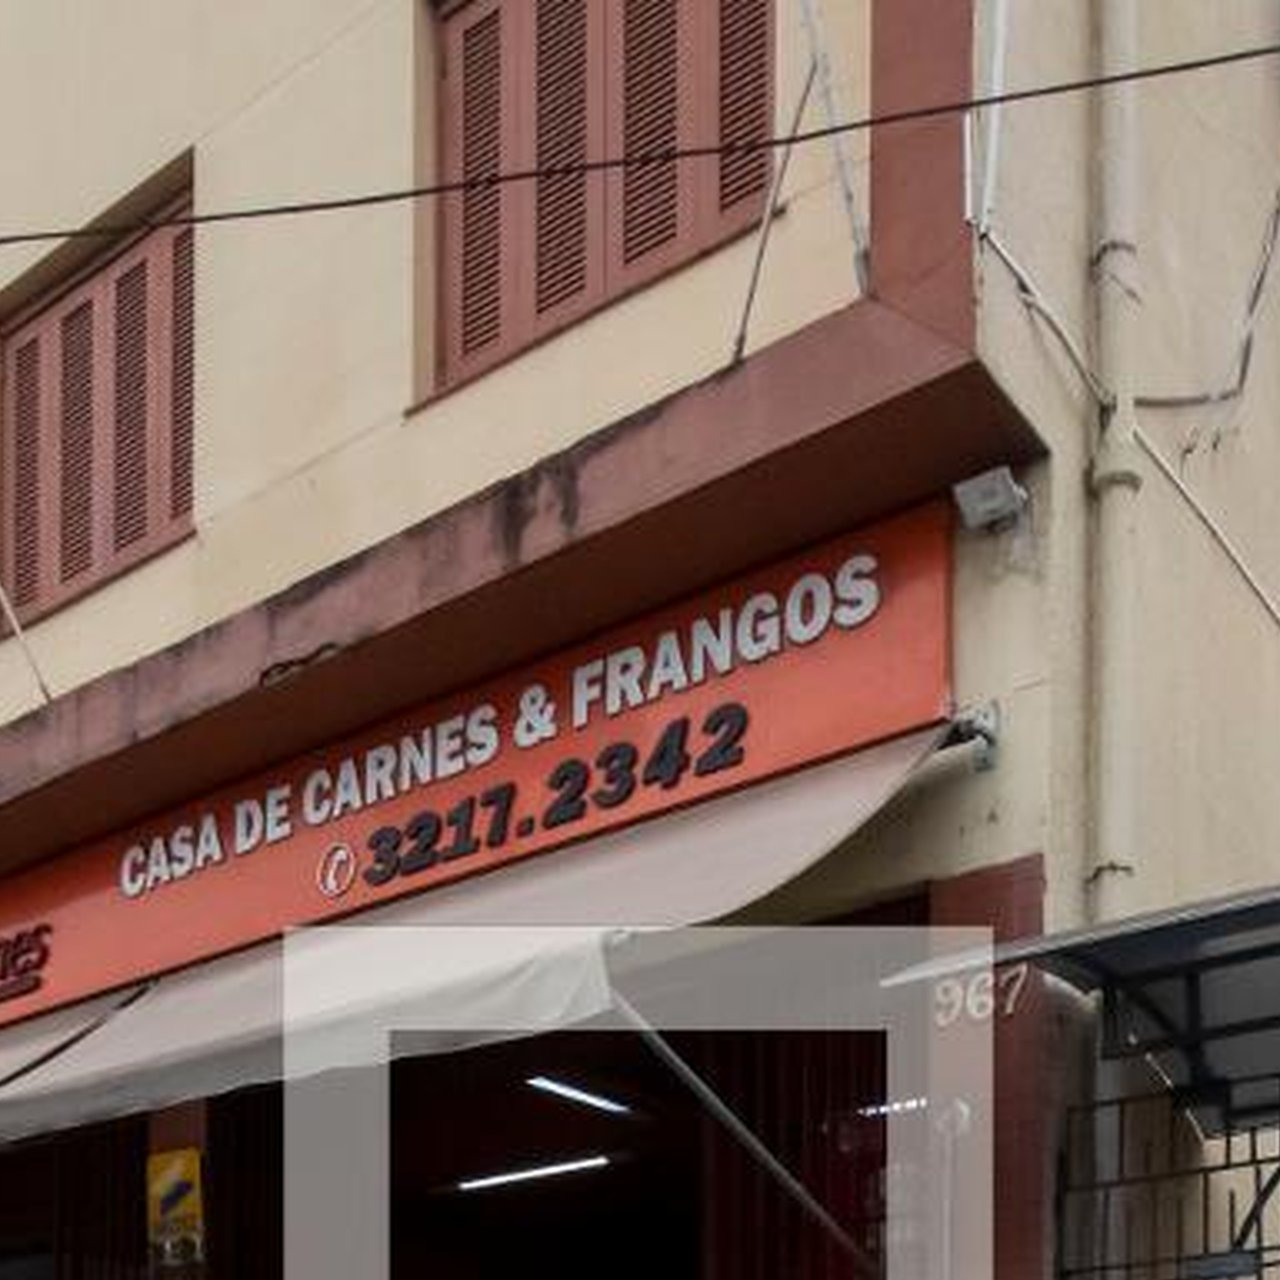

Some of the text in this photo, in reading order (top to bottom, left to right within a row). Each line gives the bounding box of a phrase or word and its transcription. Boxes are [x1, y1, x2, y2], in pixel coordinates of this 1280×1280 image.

[121, 554, 882, 897] CASA DE CARNES & FRANGOS
[363, 702, 750, 886] 3217.2342
[934, 961, 1030, 1028] 967
